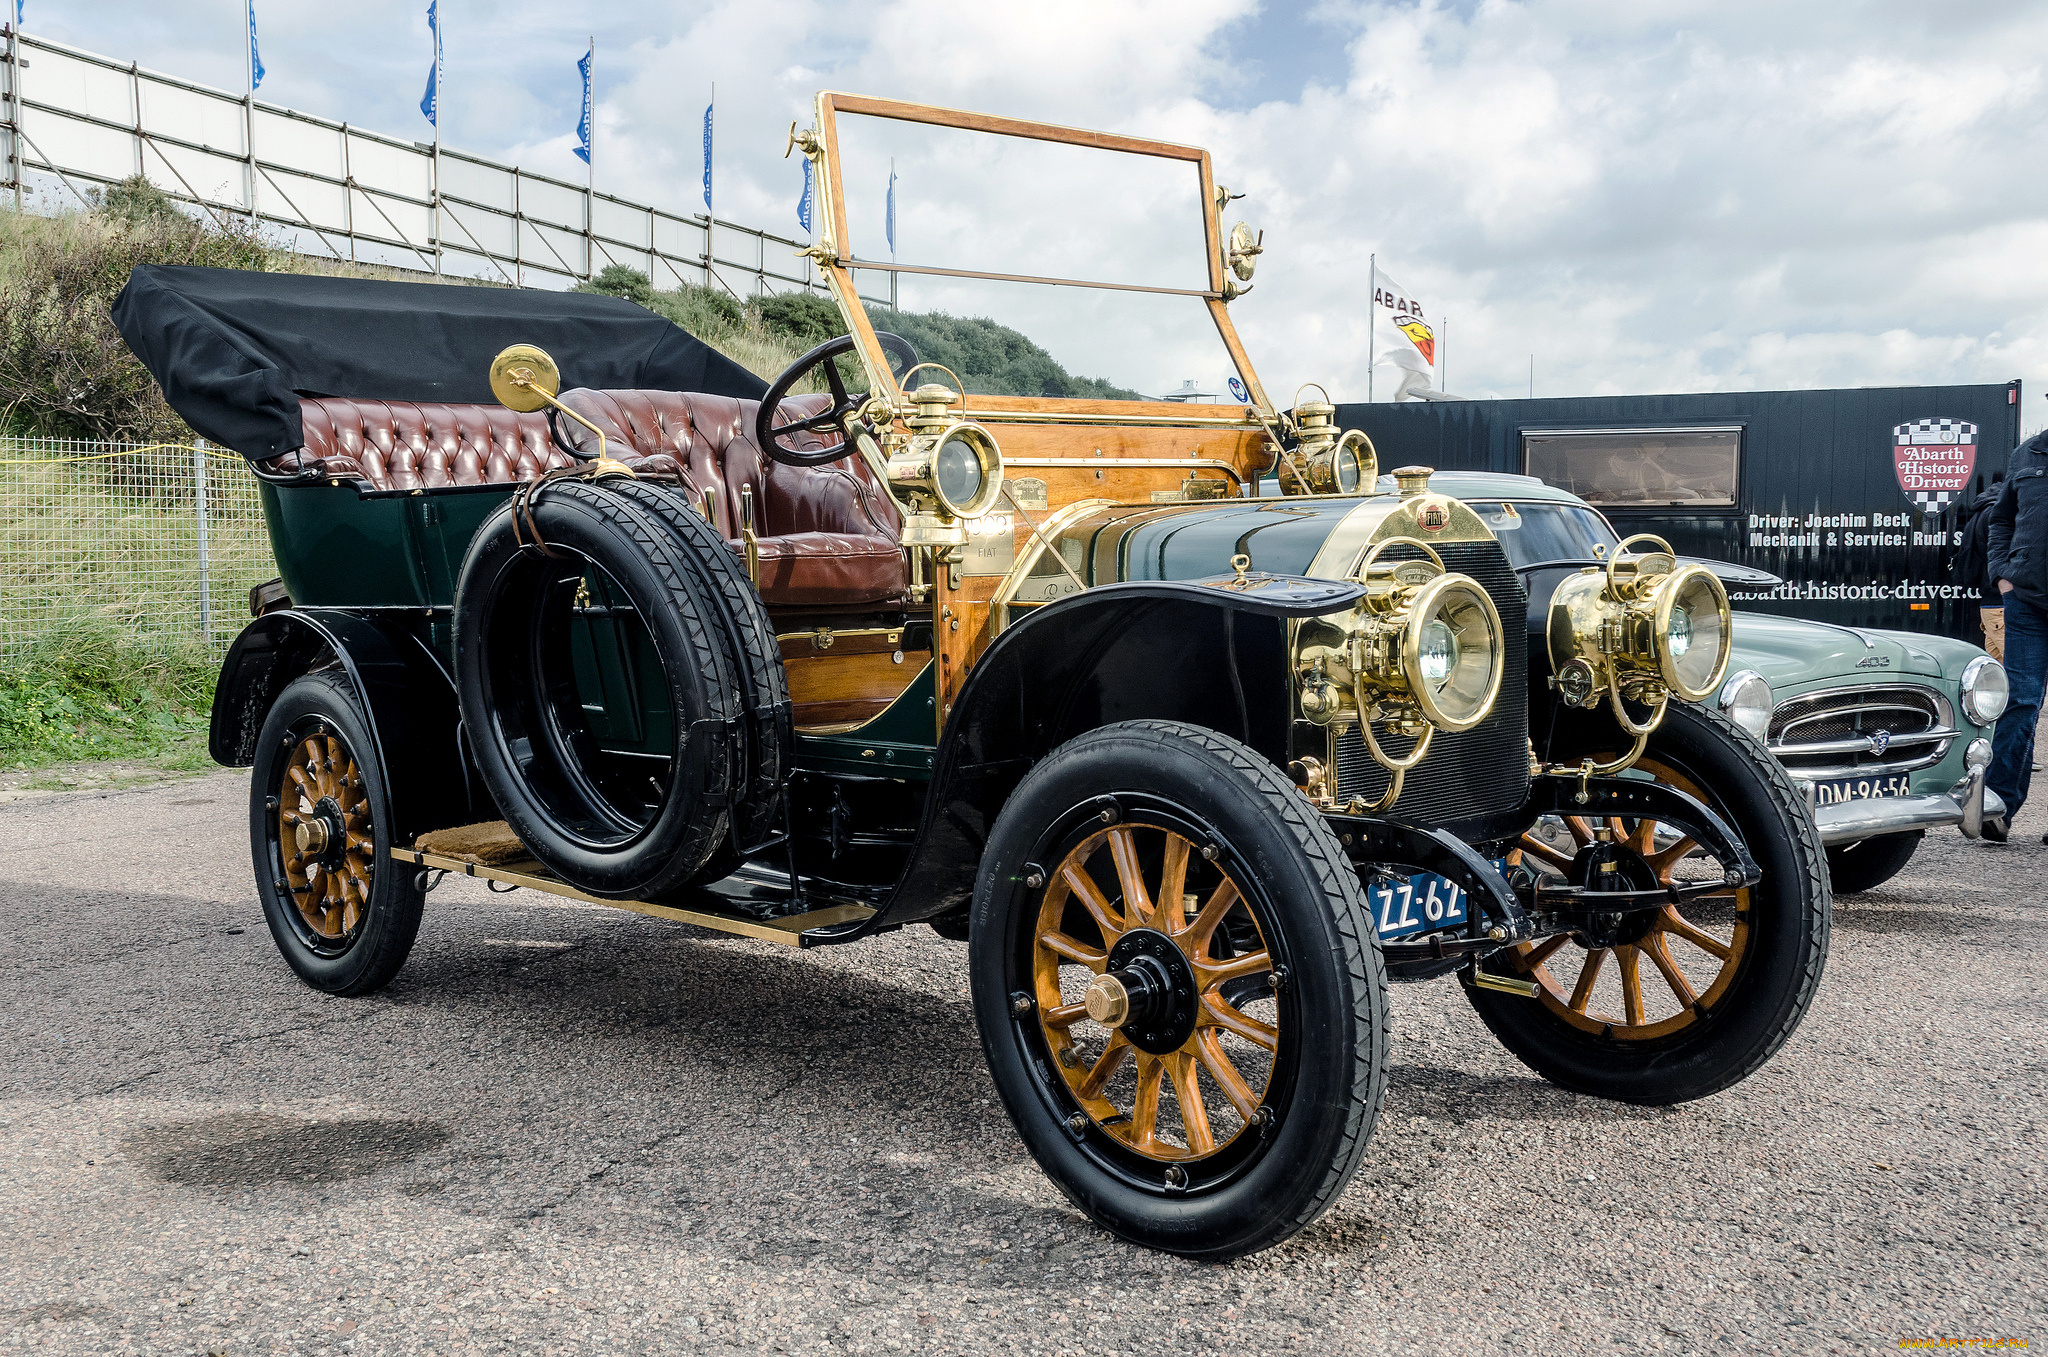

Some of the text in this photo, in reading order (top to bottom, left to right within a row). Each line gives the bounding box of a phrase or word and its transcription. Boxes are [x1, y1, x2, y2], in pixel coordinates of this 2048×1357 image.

[1374, 287, 1423, 317] ABAR
[1904, 447, 1964, 460] Abarth
[1898, 461, 1969, 475] Historic
[1904, 475, 1962, 488] Driver
[1427, 512, 1442, 525] FIAT
[1750, 512, 1910, 528] Driver: Joachim Beck
[1750, 531, 1963, 547] Mechanik & Service: Rudi S
[978, 548, 997, 557] FIAT
[1819, 776, 1910, 805] DM-96-56
